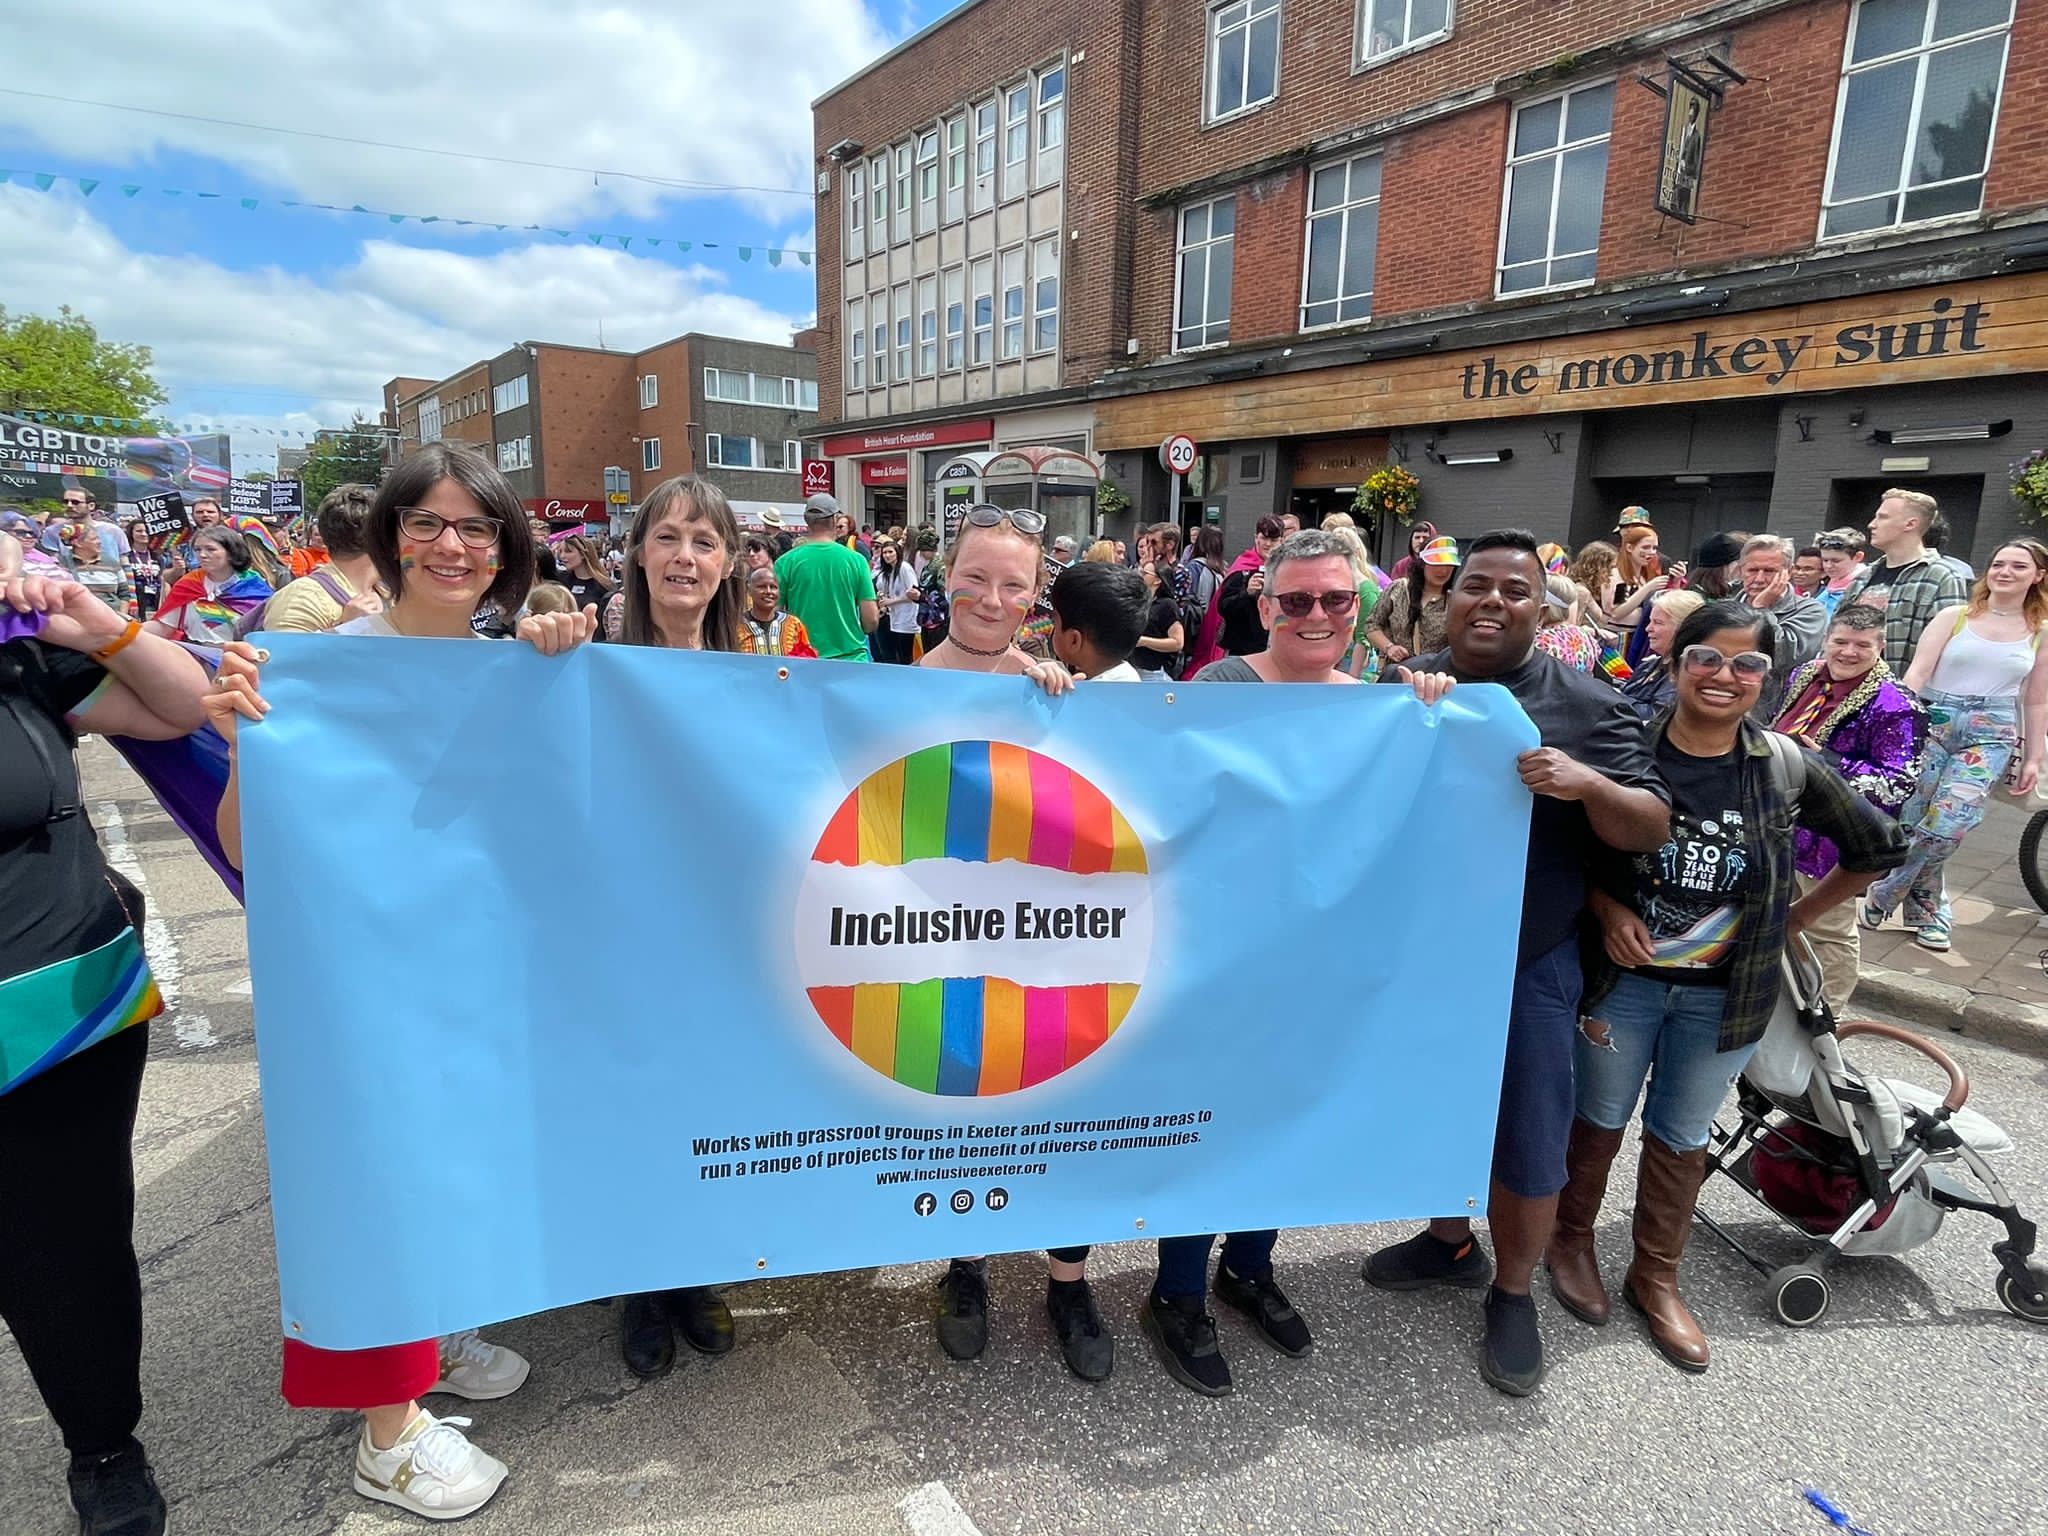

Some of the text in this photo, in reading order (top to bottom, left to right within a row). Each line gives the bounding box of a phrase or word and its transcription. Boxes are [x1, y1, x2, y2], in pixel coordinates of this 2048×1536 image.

[1457, 296, 1991, 400] the monkey suit
[0, 424, 127, 456] LGBTQ+
[864, 432, 935, 448] British Heart Foundation
[0, 448, 128, 468] STAFF NETWORK
[1172, 446, 1193, 462] 20
[949, 465, 968, 477] cash
[138, 498, 165, 513] We
[545, 500, 589, 518] Consol
[144, 509, 169, 523] are
[146, 519, 182, 536] here
[1684, 841, 1721, 864] 50
[1682, 870, 1697, 878] OF
[1684, 860, 1717, 874] YEARS
[1681, 878, 1714, 892] PRIDE
[830, 902, 1126, 946] Inclusive Exeter
[692, 1109, 1212, 1156] Works with grassroot groups in Exeter and surrounding areas to
[700, 1130, 1202, 1180] run a range of projects for the benefit of diverse communities.
[876, 1163, 1047, 1186] www.inclusiveexeter.org
